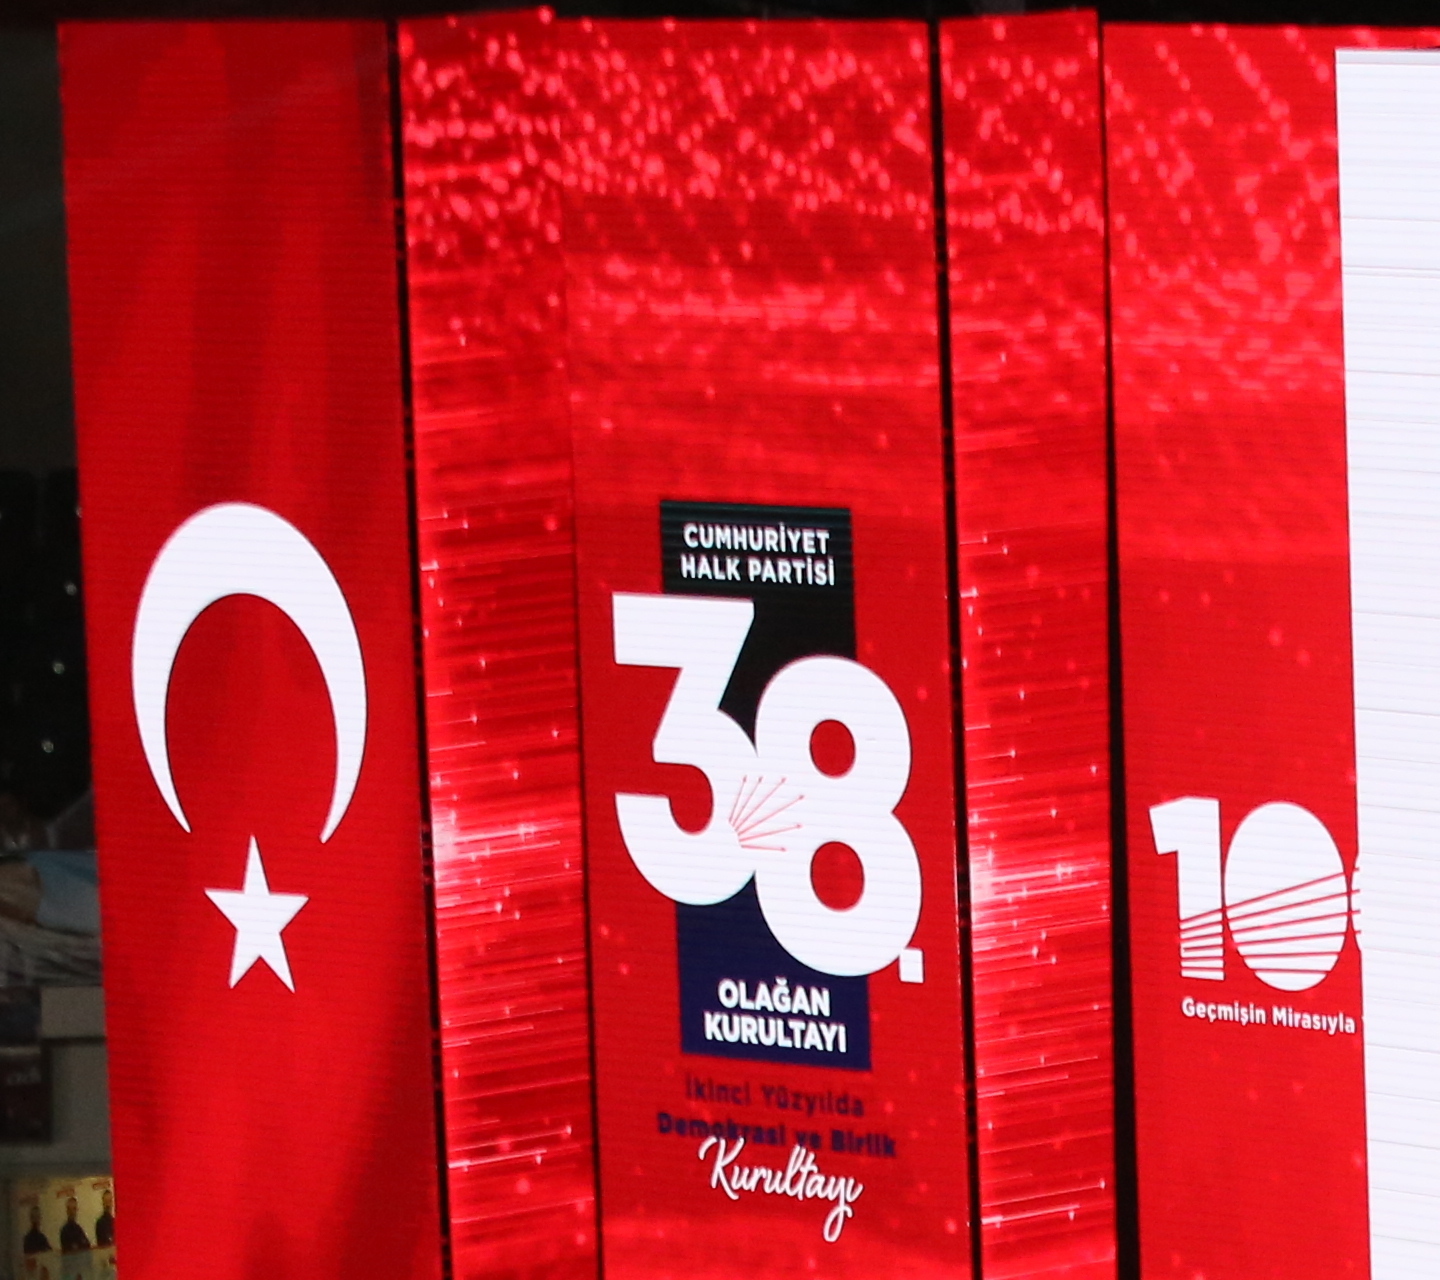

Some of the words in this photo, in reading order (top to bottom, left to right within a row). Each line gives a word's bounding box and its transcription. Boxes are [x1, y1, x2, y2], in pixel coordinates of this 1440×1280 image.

[684, 521, 830, 556] CUMHURİYET
[681, 556, 742, 583] HALK
[747, 555, 836, 588] PARTİSİ
[1149, 796, 1362, 992] 10
[717, 976, 831, 1019] OLAĞAN
[1181, 997, 1267, 1027] Geçmişin
[1273, 1006, 1357, 1036] Mirasıyla
[703, 1016, 848, 1053] KURULTAYI
[761, 1085, 866, 1118] Yüzyılda
[656, 1111, 787, 1146] Demokrasi
[795, 1130, 823, 1151] ve
[831, 1128, 897, 1158] Birlik
[698, 1135, 864, 1244] Kurultayı
